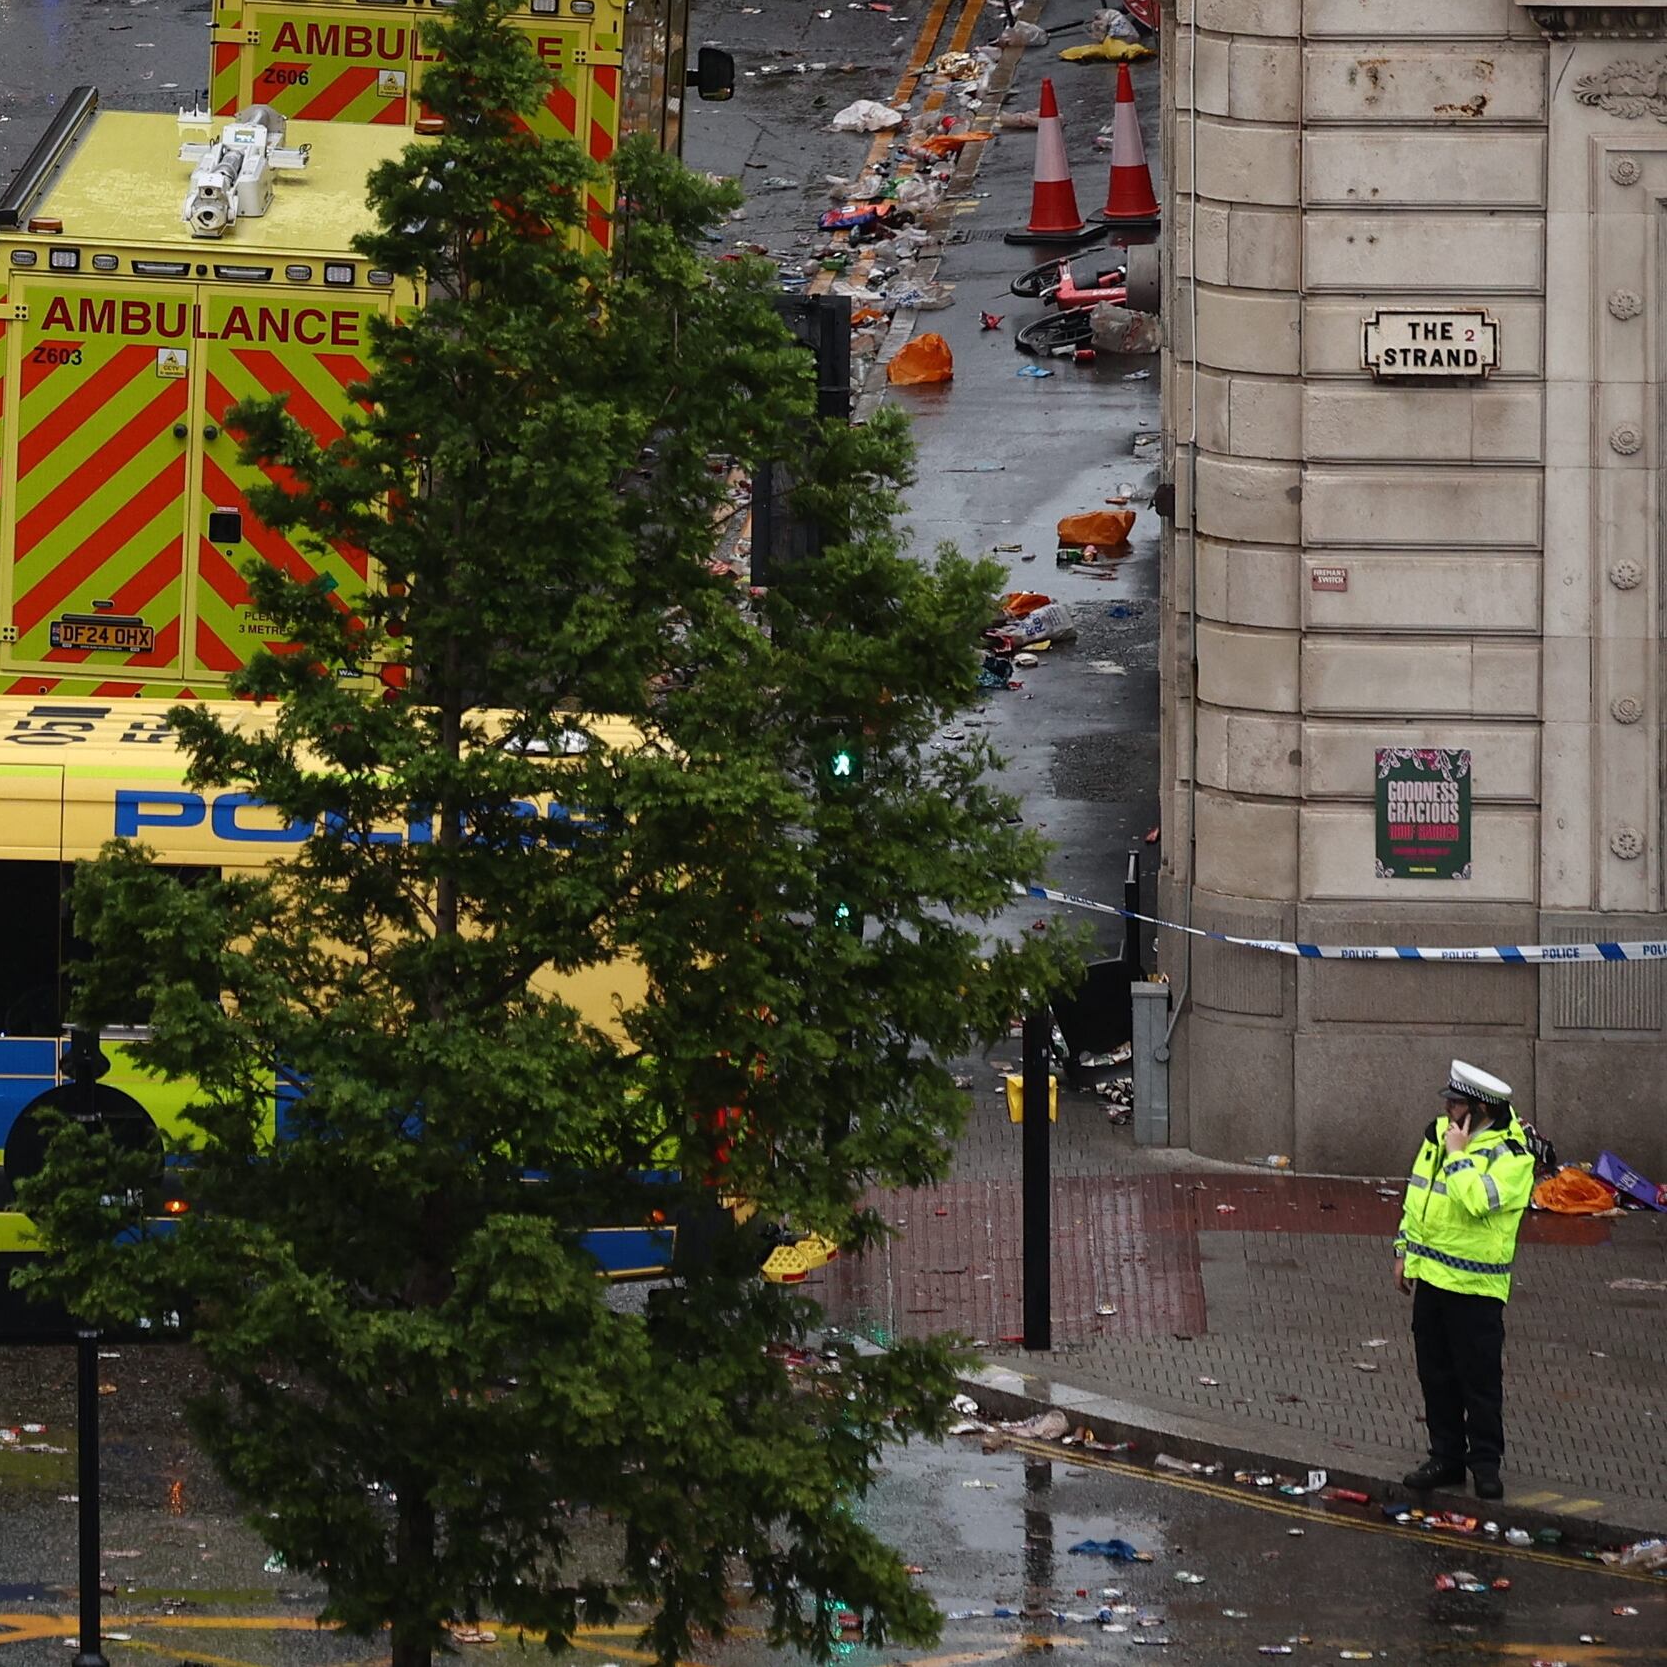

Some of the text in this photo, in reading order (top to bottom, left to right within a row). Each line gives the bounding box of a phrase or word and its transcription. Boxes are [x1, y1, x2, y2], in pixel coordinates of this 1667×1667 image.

[263, 68, 309, 85] Z606
[41, 296, 360, 346] AMBULANCE
[1408, 322, 1475, 342] THE 2
[33, 347, 82, 365] Z603
[1384, 348, 1478, 367] STRAND
[63, 624, 150, 647] DF24 OHX
[239, 624, 244, 633] 3
[1388, 780, 1459, 802] GOODNESS
[1387, 802, 1459, 823] GRACIOUS
[1442, 950, 1479, 960] POLICE
[1542, 947, 1579, 959] POLICE
